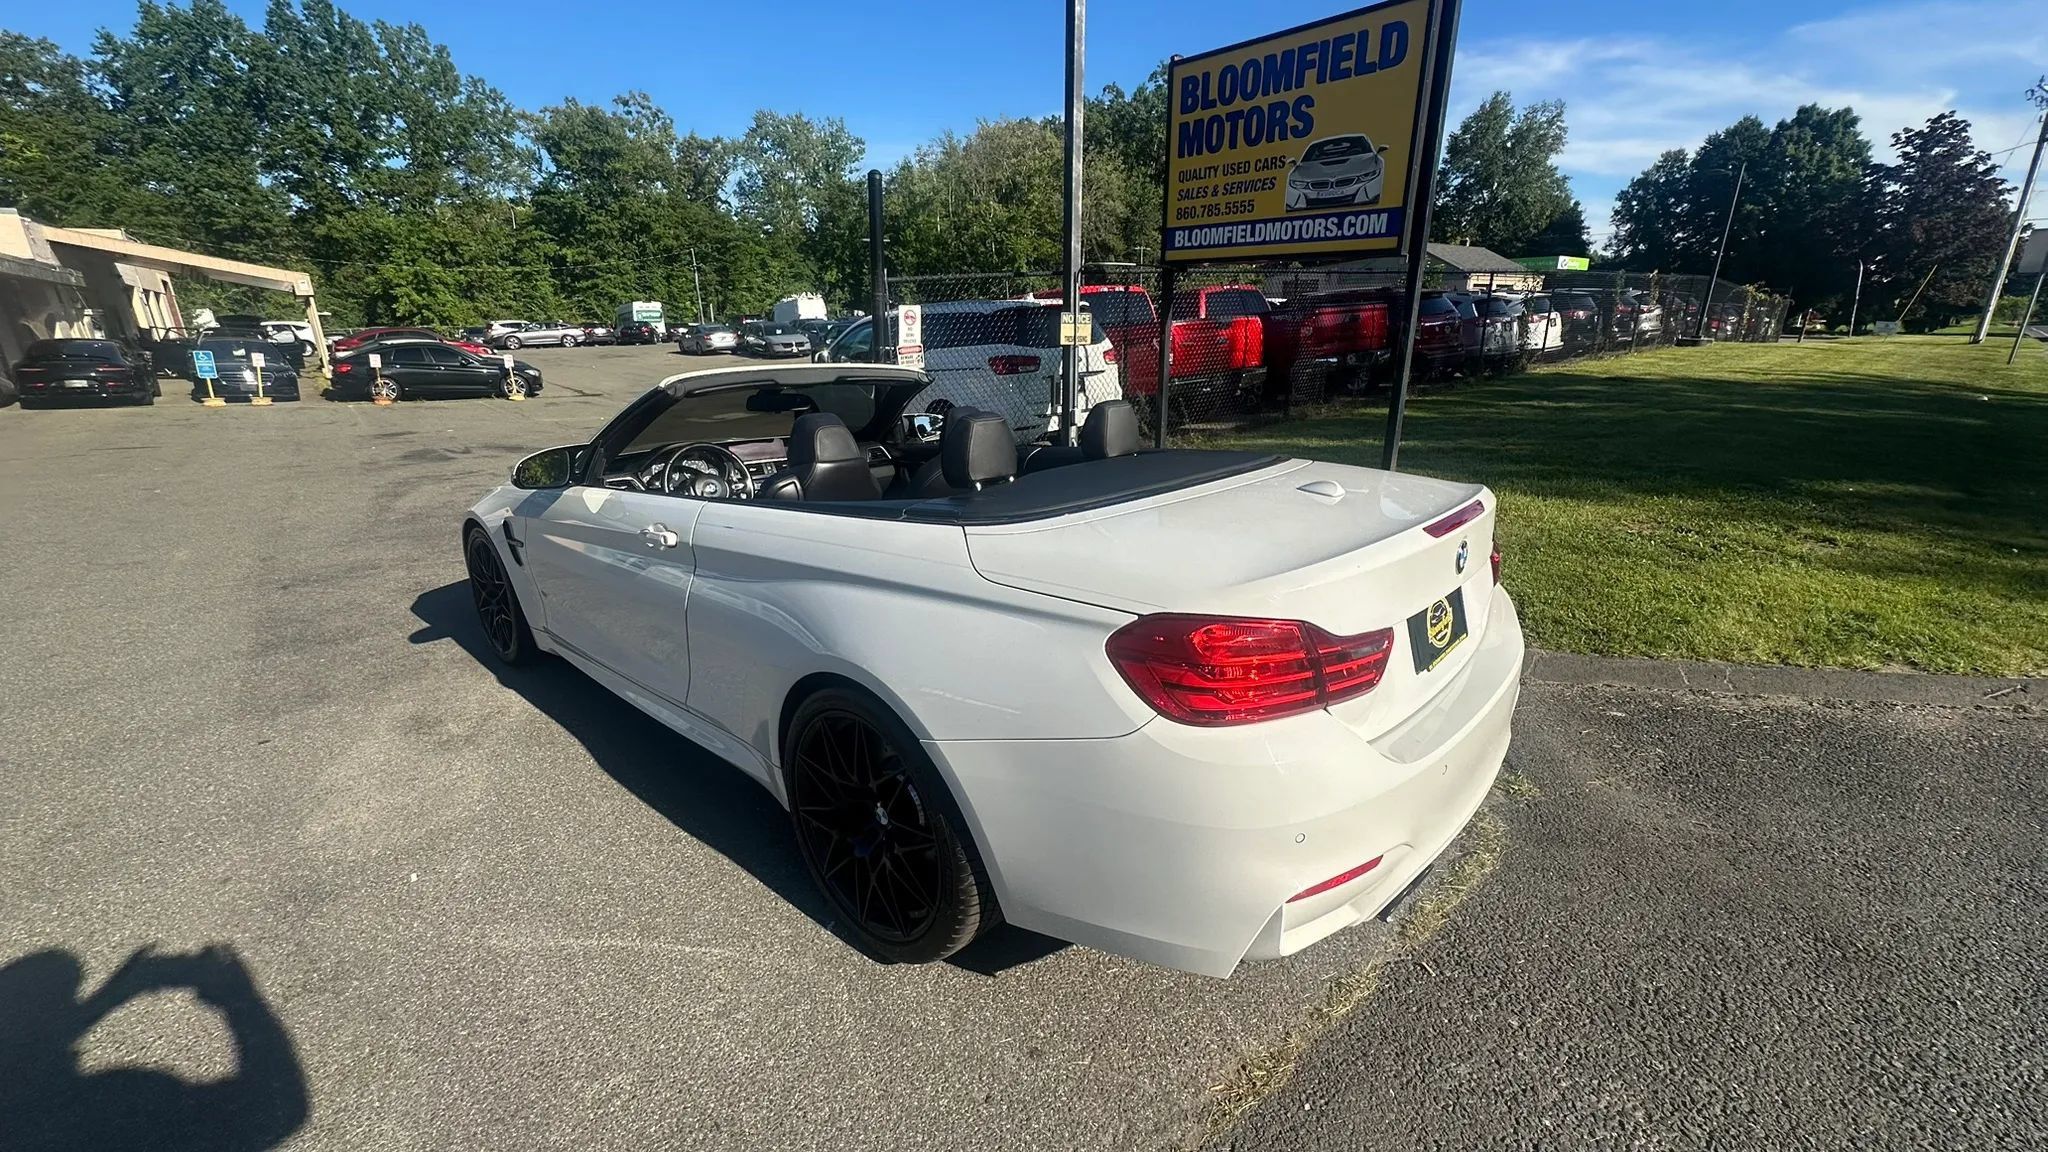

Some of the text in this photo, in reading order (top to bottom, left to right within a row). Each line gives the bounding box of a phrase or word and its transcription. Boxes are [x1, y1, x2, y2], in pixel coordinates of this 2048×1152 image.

[1180, 21, 1409, 115] BLOOMFIELD
[1177, 94, 1315, 159] MOTORS
[1178, 154, 1287, 184] QUALITY USED CARS
[1177, 176, 1277, 202] SALES & SERVICES
[1176, 199, 1255, 221] 860.785.5555
[1174, 212, 1389, 248] BLOOMFIELDMOTORS.COM
[1062, 314, 1091, 324] NOICE
